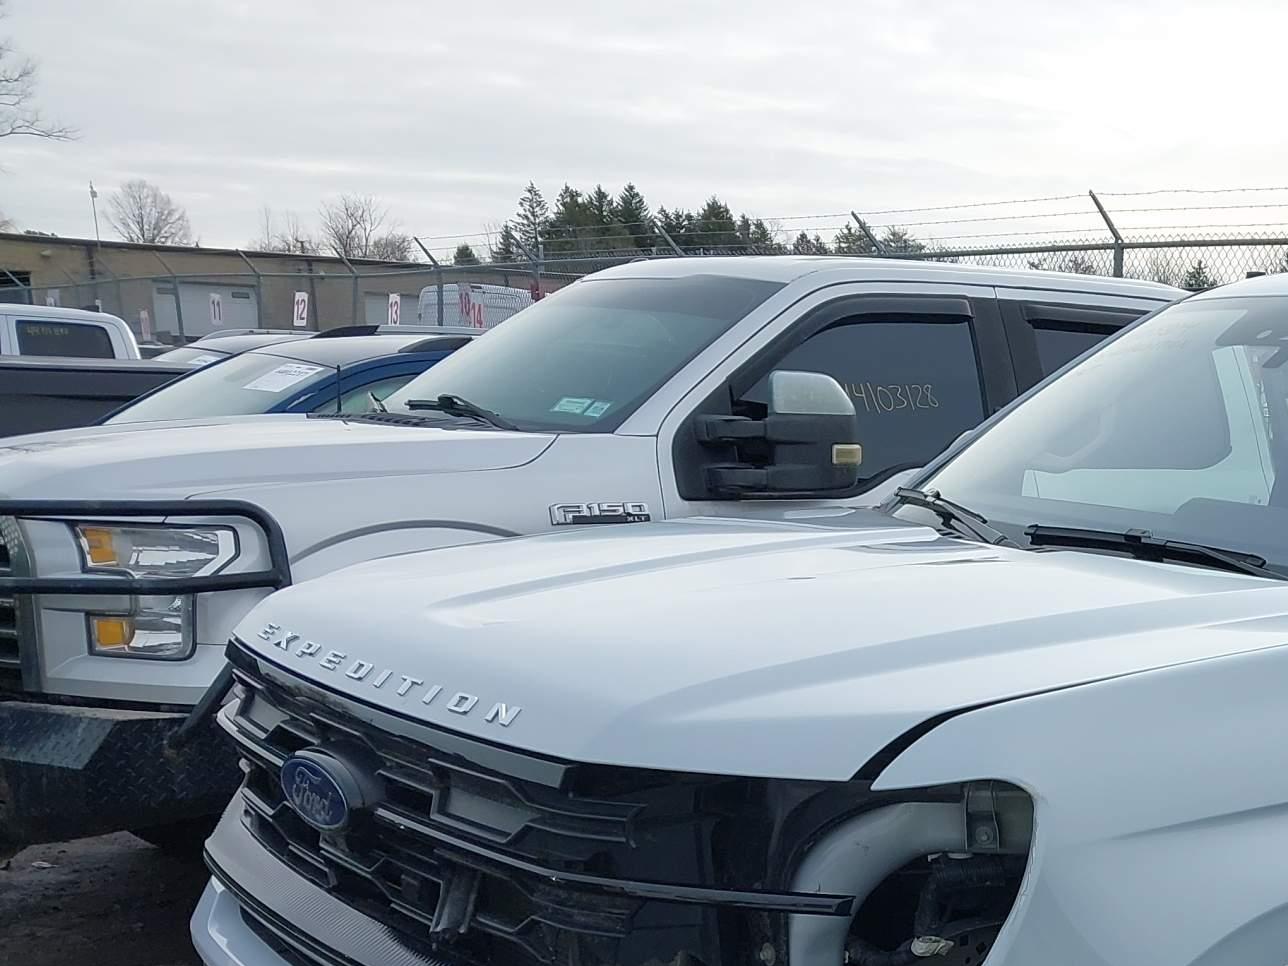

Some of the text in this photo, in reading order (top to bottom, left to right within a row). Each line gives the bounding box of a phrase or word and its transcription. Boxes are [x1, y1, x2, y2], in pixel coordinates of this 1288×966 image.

[211, 299, 221, 321] 11
[295, 298, 306, 321] 12
[390, 300, 399, 325] 13
[471, 302, 483, 328] 14
[255, 622, 523, 727] EXPEDITION
[291, 766, 333, 820] Ford
